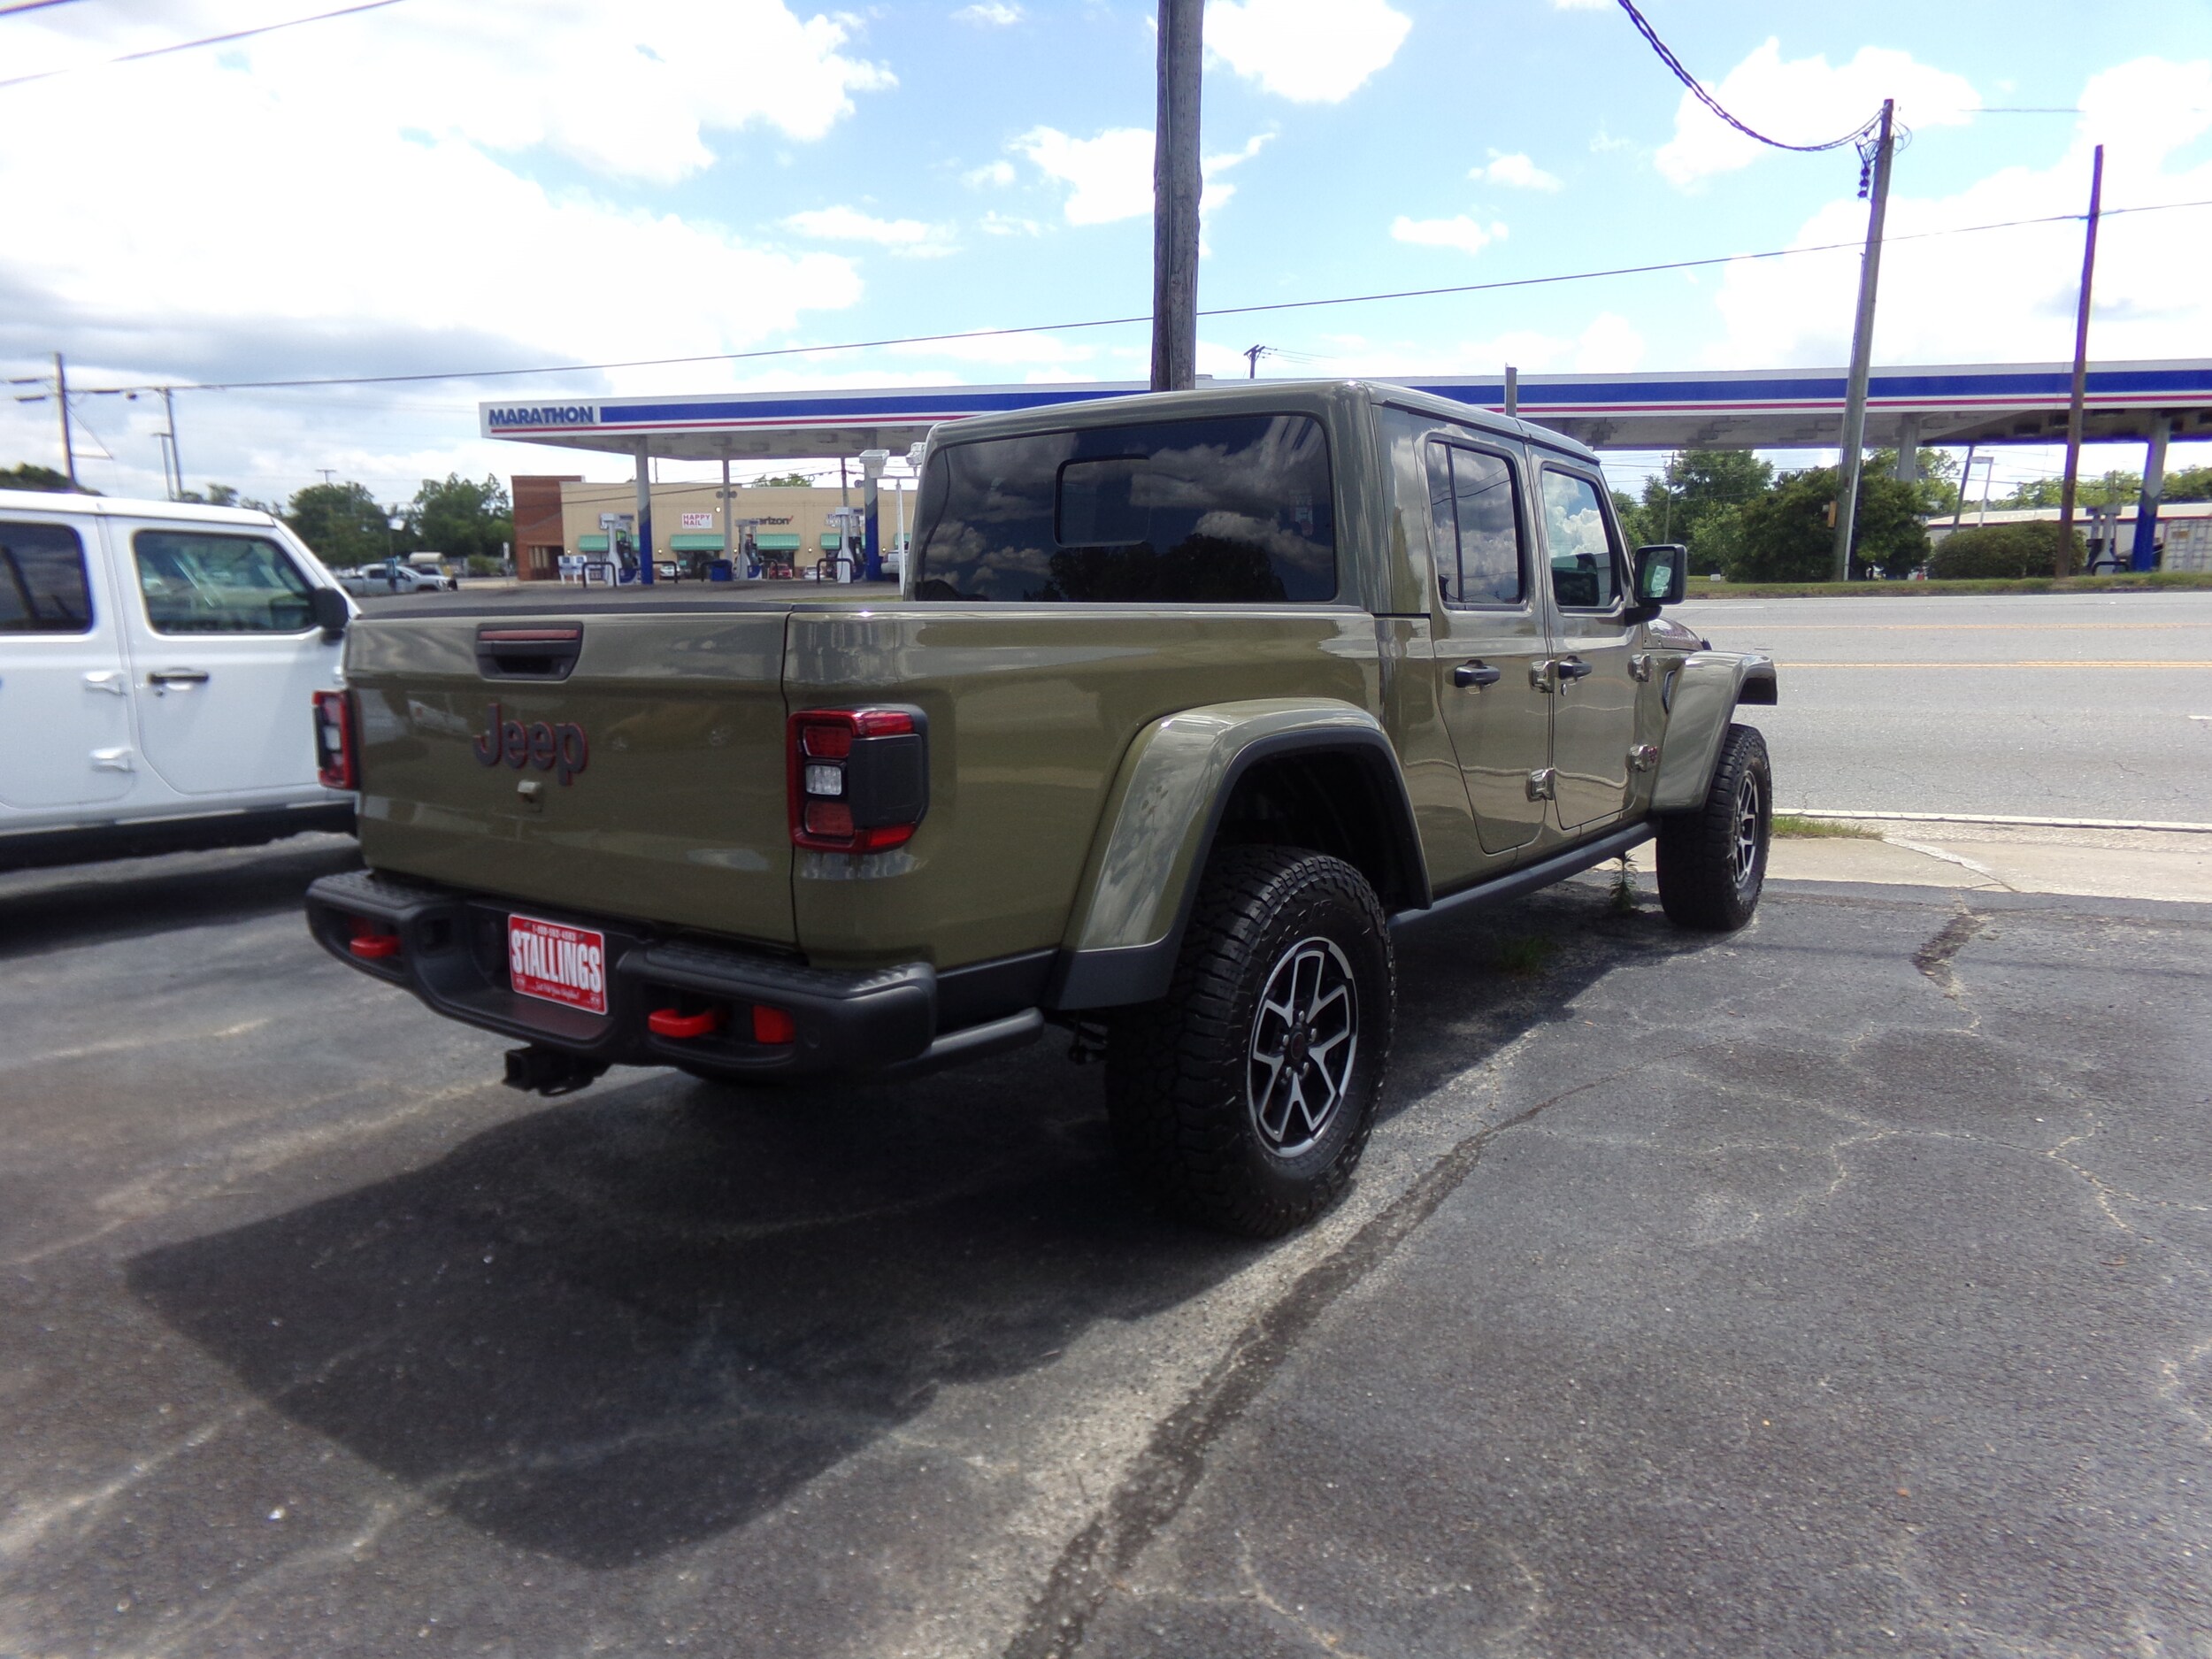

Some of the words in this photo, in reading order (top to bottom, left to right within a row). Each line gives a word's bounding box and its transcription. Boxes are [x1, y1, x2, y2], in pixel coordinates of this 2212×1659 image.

[488, 406, 594, 425] MARATHON
[755, 516, 789, 526] erizon
[473, 703, 589, 786] Jeep
[511, 929, 603, 994] STALLINGS
